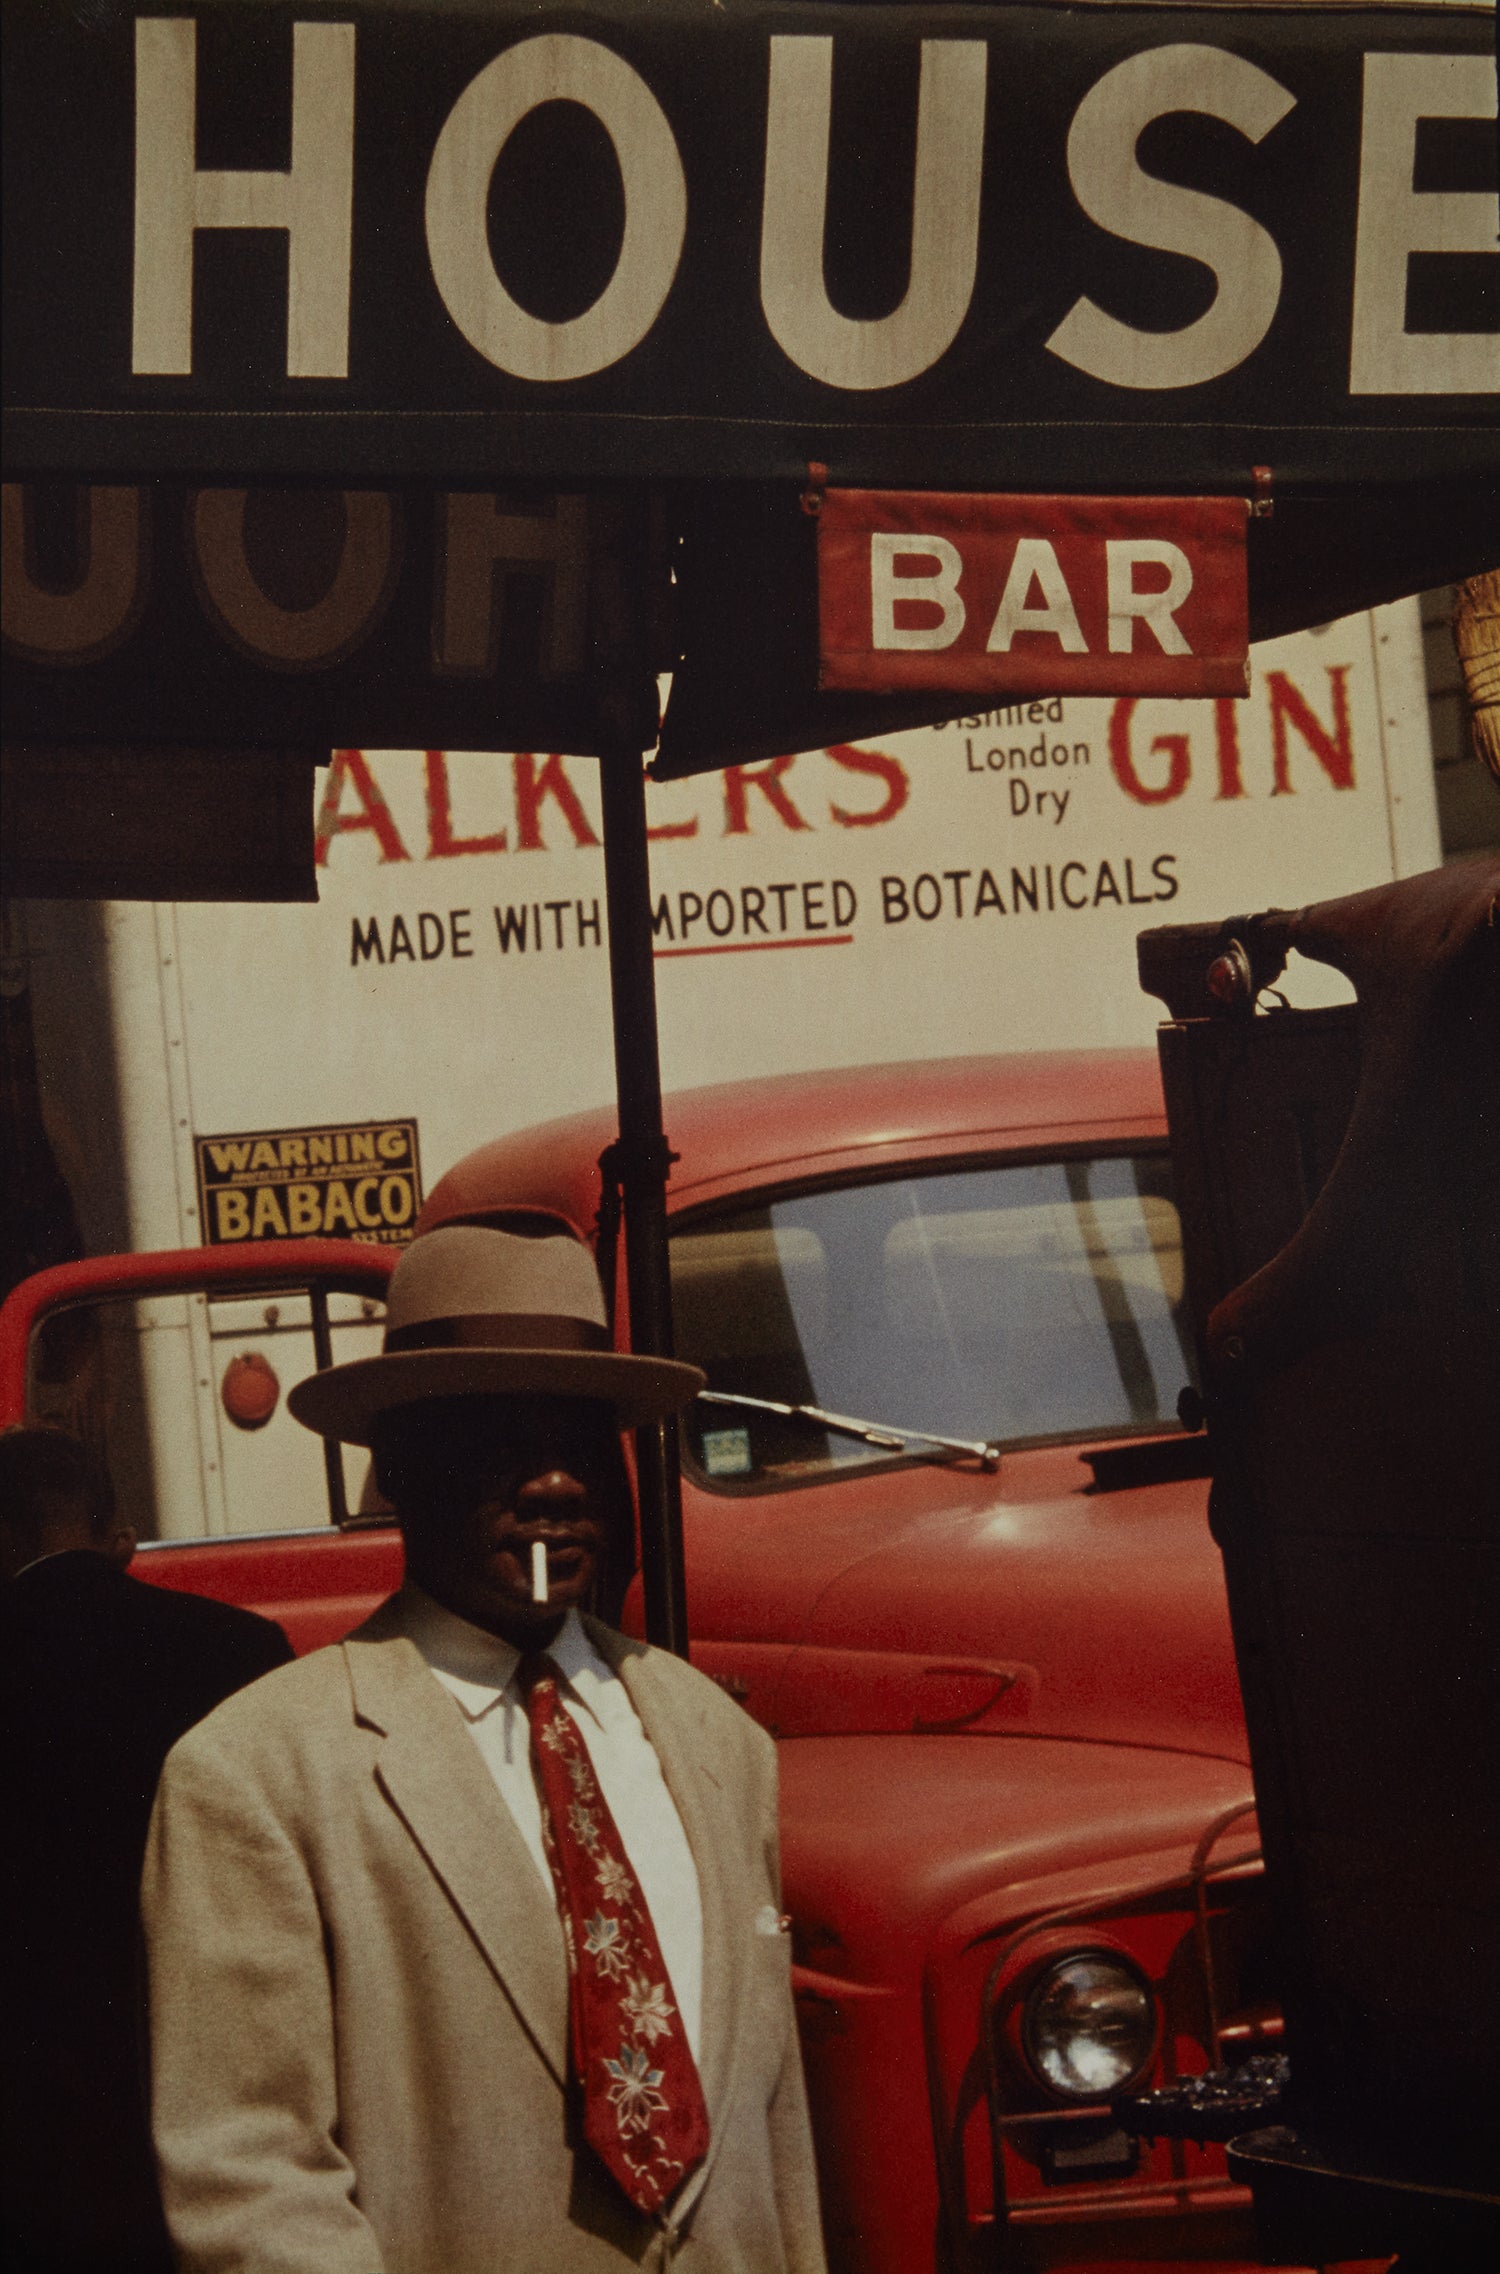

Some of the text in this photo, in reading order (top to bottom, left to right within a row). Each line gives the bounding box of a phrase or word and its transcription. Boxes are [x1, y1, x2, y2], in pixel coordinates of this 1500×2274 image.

[132, 17, 1498, 395] HOUSE
[870, 532, 1194, 655] BAR
[966, 734, 1090, 773] London
[1108, 663, 1356, 806] GIN
[1010, 778, 1070, 824] Dry
[350, 855, 1179, 966] MADE WITH MPORTED BOTANICALS
[208, 1130, 407, 1173] WARNING
[216, 1176, 413, 1240] BABACO
